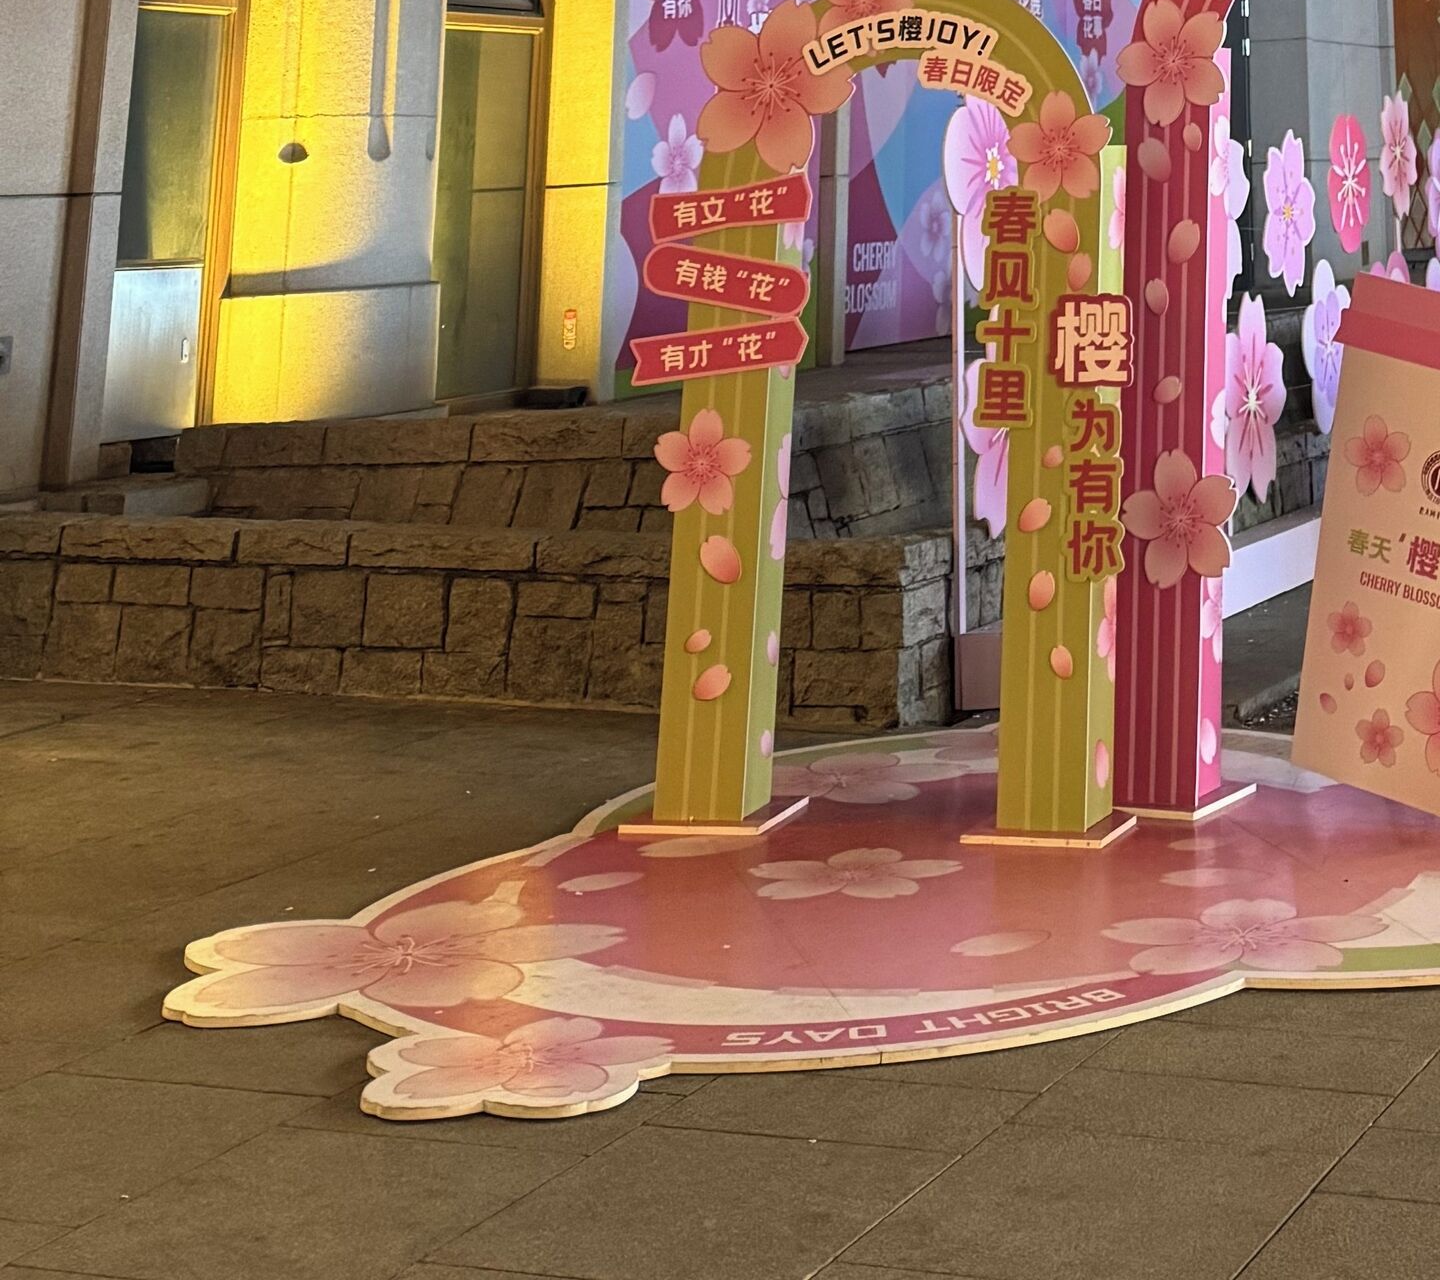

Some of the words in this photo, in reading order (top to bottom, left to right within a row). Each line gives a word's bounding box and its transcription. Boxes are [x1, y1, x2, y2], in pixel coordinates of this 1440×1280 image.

[924, 56, 1025, 110] 春日限定
[980, 192, 1036, 423] 春风十里
[1360, 571, 1401, 596] CHERRY
[915, 989, 1127, 1034] BRIGHT
[722, 1024, 886, 1046] DAYS
